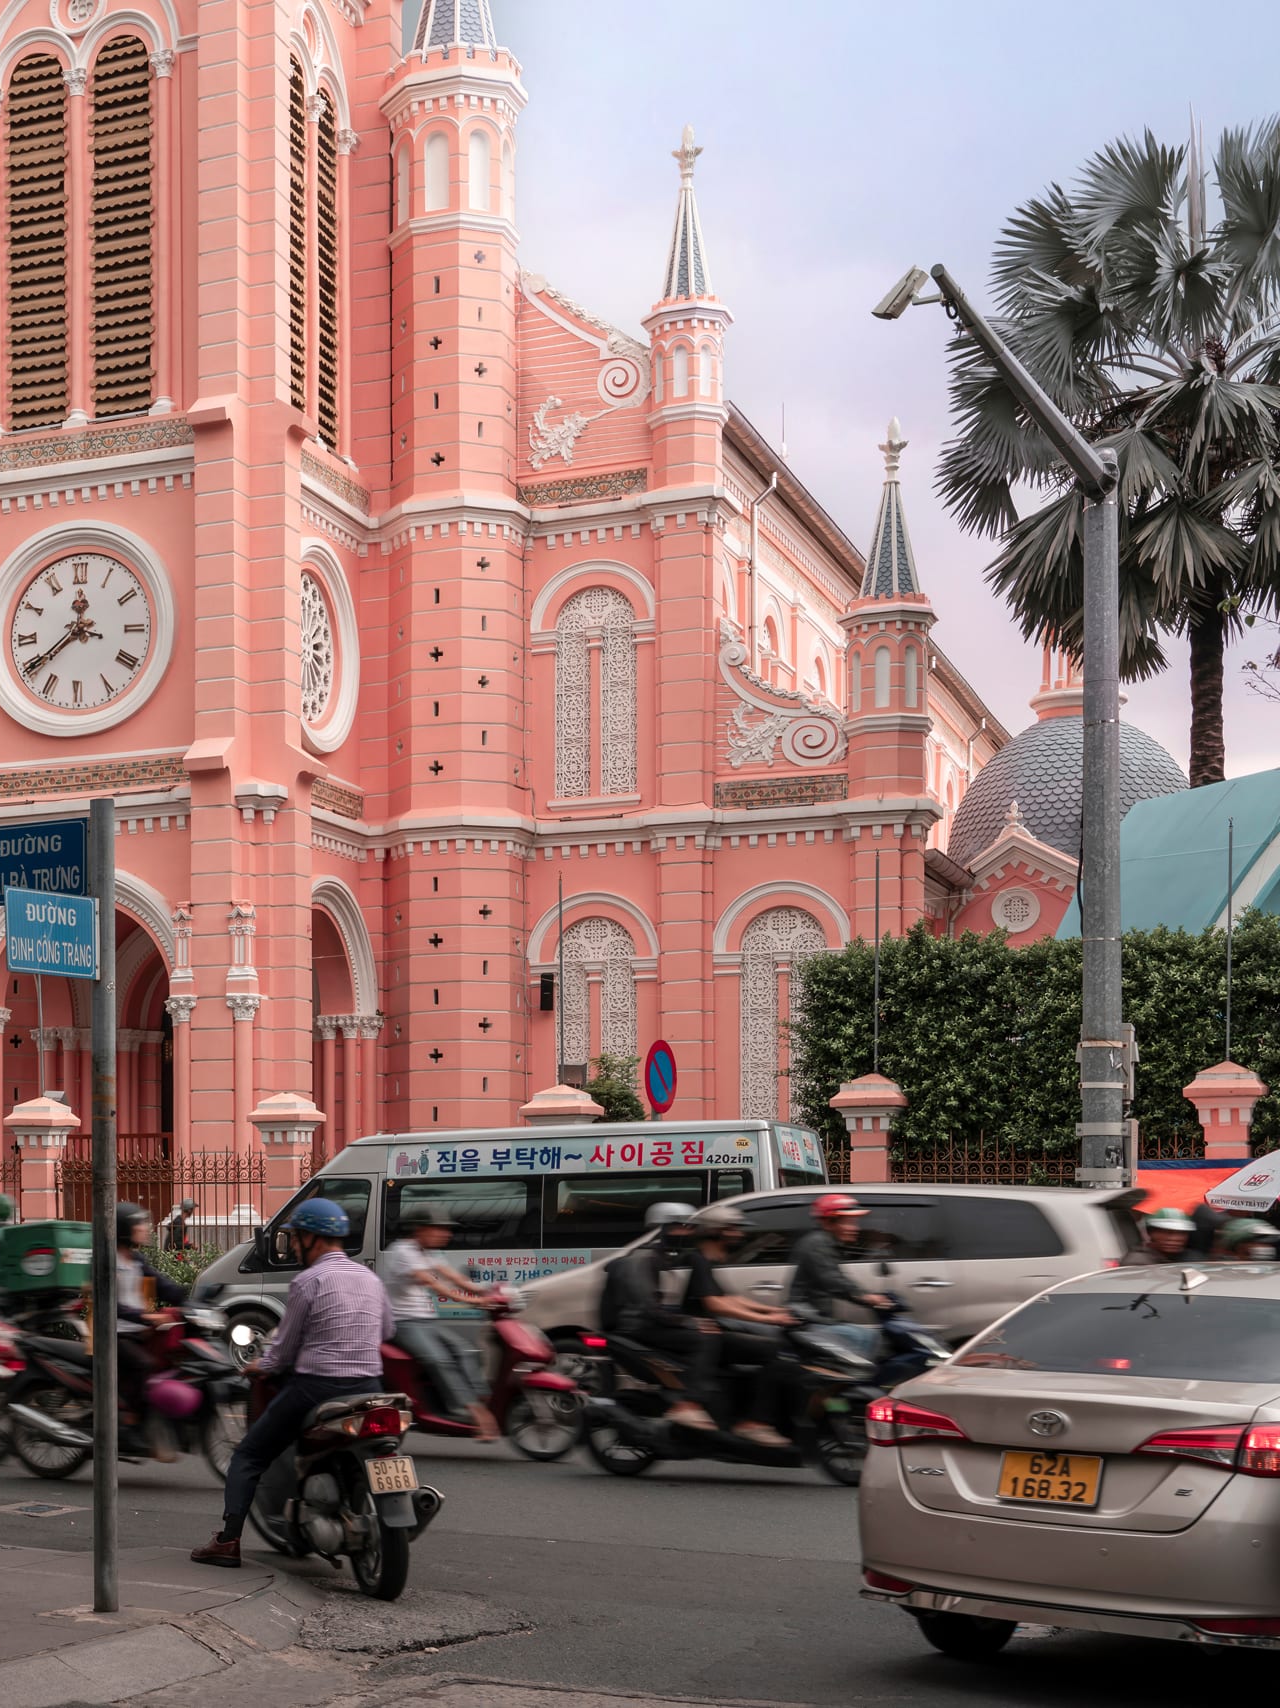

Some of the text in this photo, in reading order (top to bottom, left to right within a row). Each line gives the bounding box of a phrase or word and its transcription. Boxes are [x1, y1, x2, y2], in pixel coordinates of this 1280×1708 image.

[0, 833, 62, 857] ĐƯỜNG
[10, 864, 28, 888] BÀ
[32, 865, 80, 892] TRƯNG
[26, 901, 77, 927] ĐƯỜNG
[11, 934, 92, 967] ĐINH CÔNG TRÁNG
[436, 1150, 480, 1173] 짐을
[706, 1153, 753, 1165] 420zim
[478, 1256, 502, 1266] 때문에
[541, 1256, 558, 1265] 하지
[561, 1256, 587, 1265] 마세요
[1029, 1454, 1071, 1477] 62A
[377, 1475, 411, 1490] 6968
[1011, 1476, 1087, 1502] 168.32
